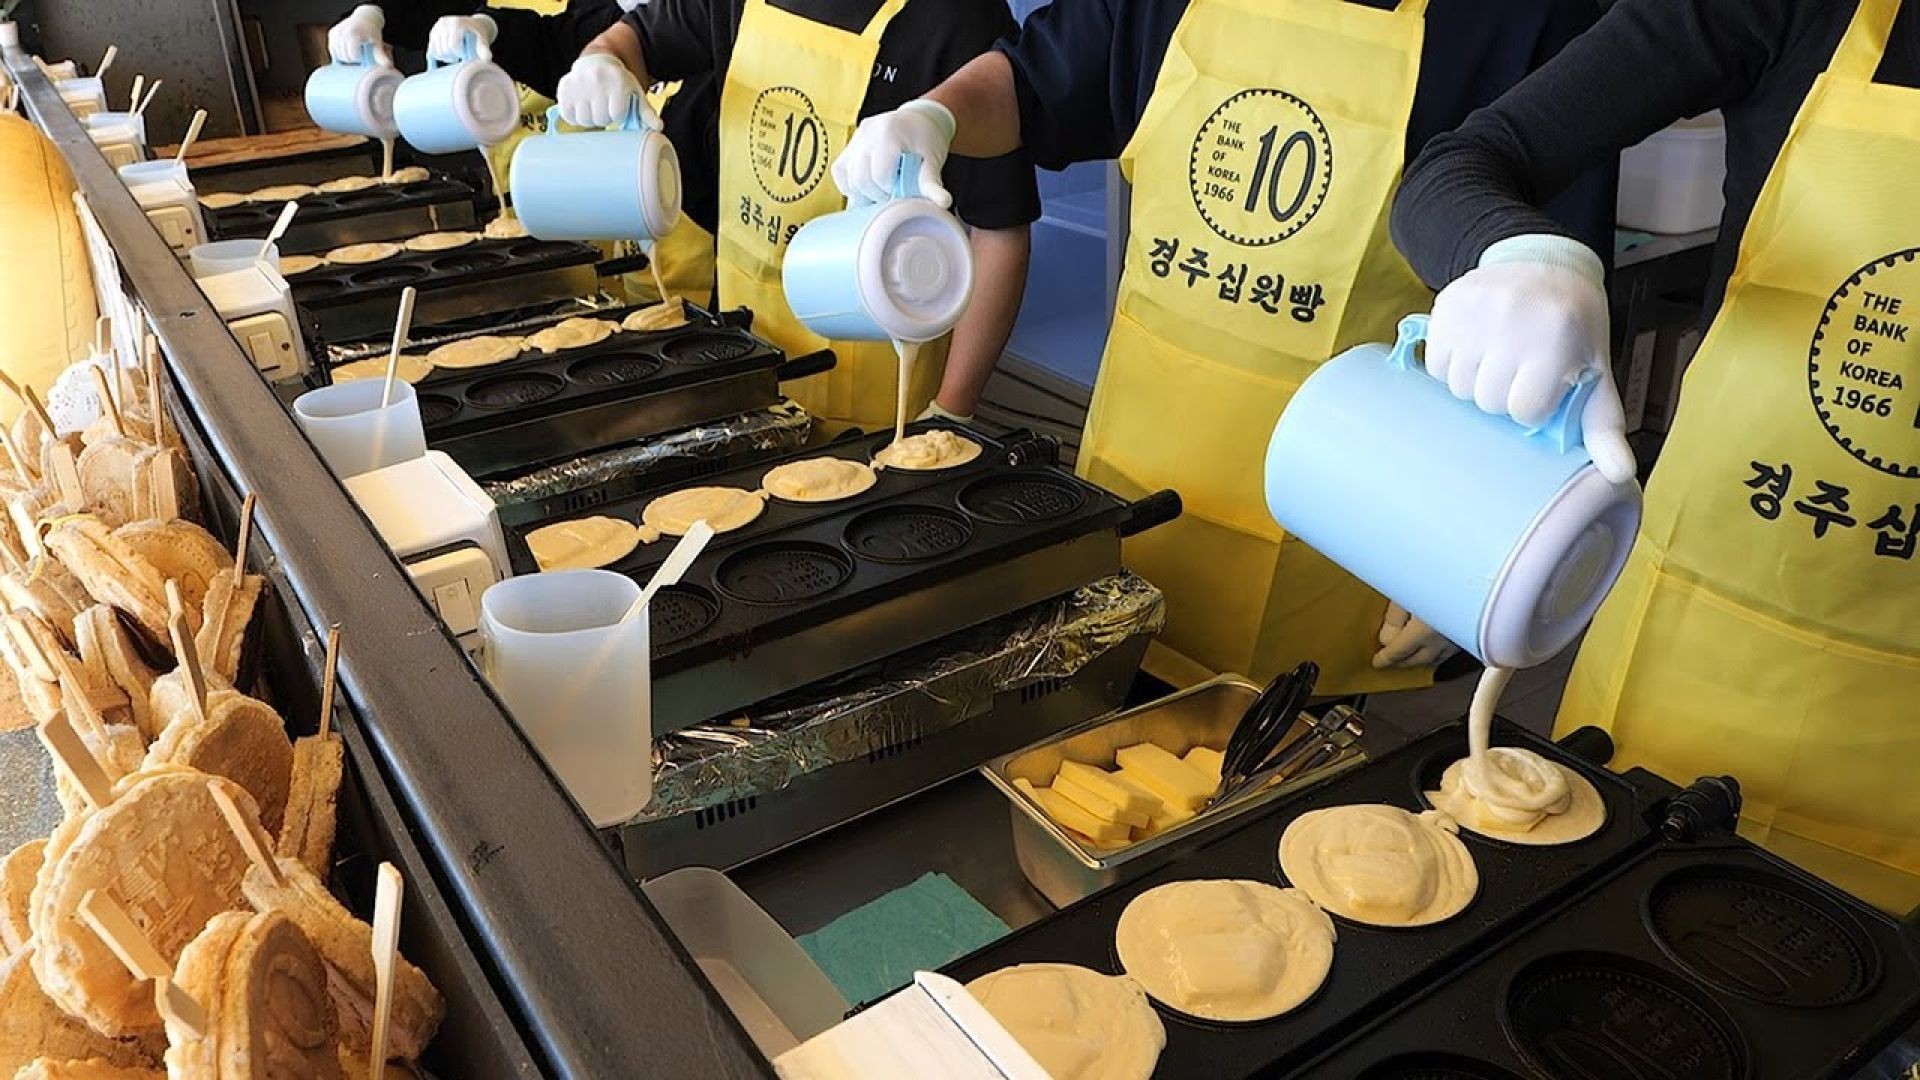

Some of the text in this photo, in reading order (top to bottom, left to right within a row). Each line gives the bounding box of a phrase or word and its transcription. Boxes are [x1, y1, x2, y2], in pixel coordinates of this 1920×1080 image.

[1223, 119, 1242, 133] THE
[778, 112, 819, 185] 10
[1216, 135, 1246, 151] BANK
[1212, 151, 1226, 162] OF
[1207, 165, 1241, 183] KOREA
[1244, 124, 1317, 222] 10
[1203, 183, 1234, 202] 1966
[1149, 237, 1325, 323] 경주십원빵
[1862, 290, 1902, 315] THE
[1853, 314, 1908, 343] BANK
[1846, 338, 1873, 356] OF
[1839, 360, 1903, 391] KOREA
[1831, 386, 1892, 418] 1966
